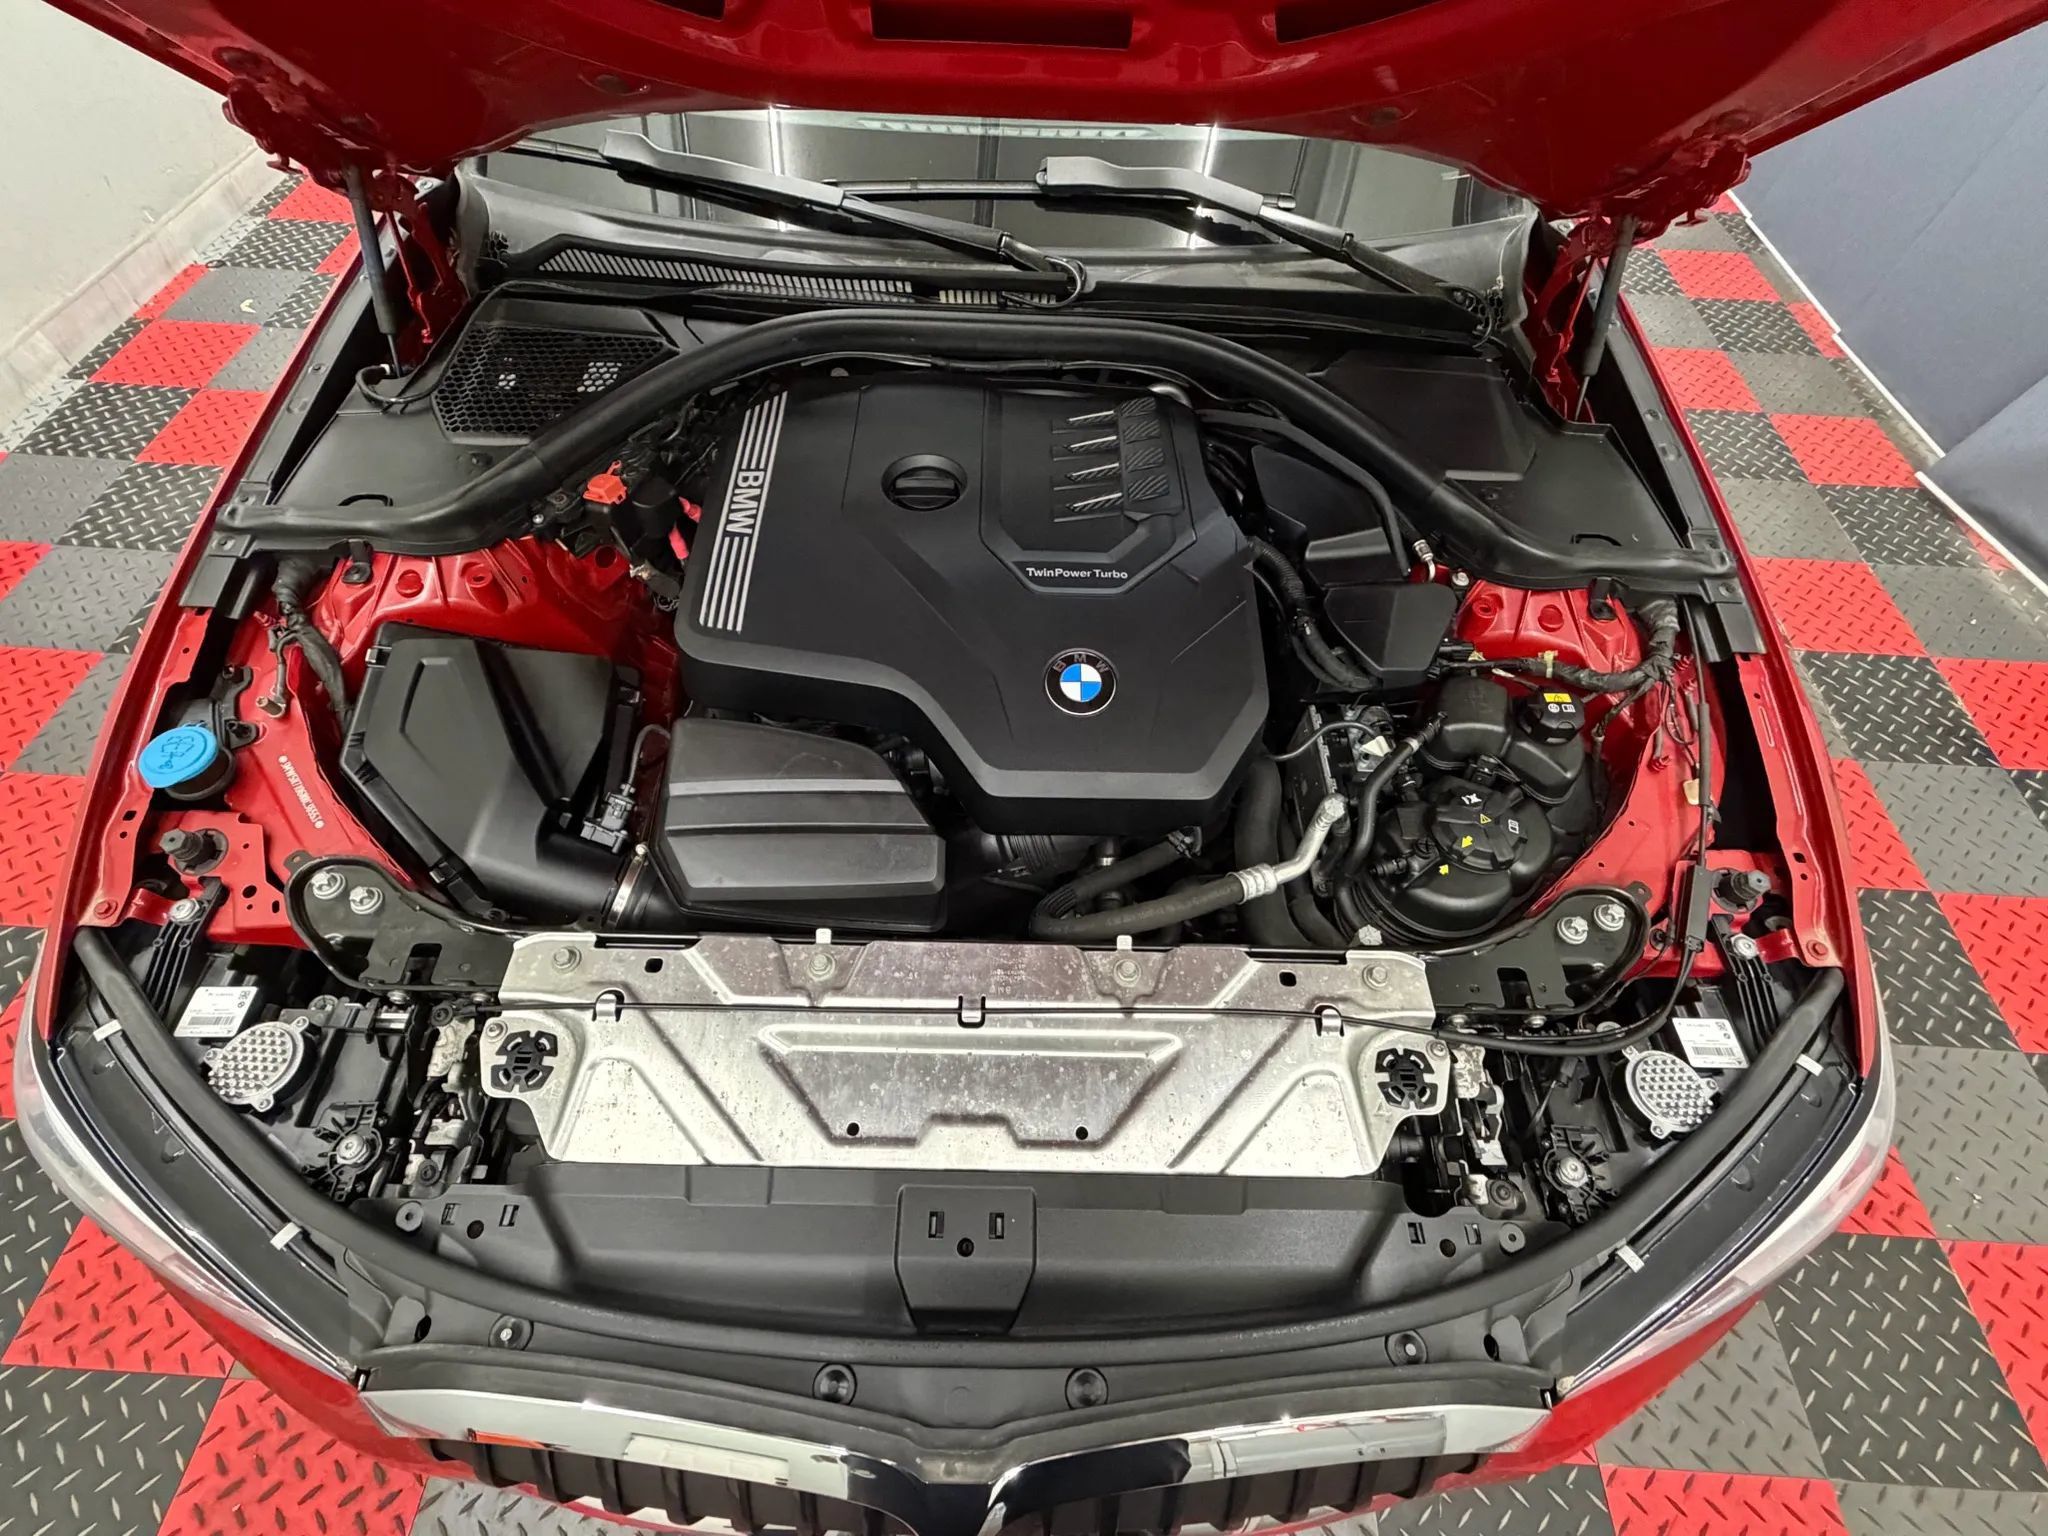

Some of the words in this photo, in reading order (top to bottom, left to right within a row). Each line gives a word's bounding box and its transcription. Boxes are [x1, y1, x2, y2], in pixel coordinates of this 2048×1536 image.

[725, 471, 765, 534] BMW
[1026, 567, 1092, 578] TwinPower
[1093, 569, 1128, 579] Turbo
[1052, 654, 1110, 673] BMW
